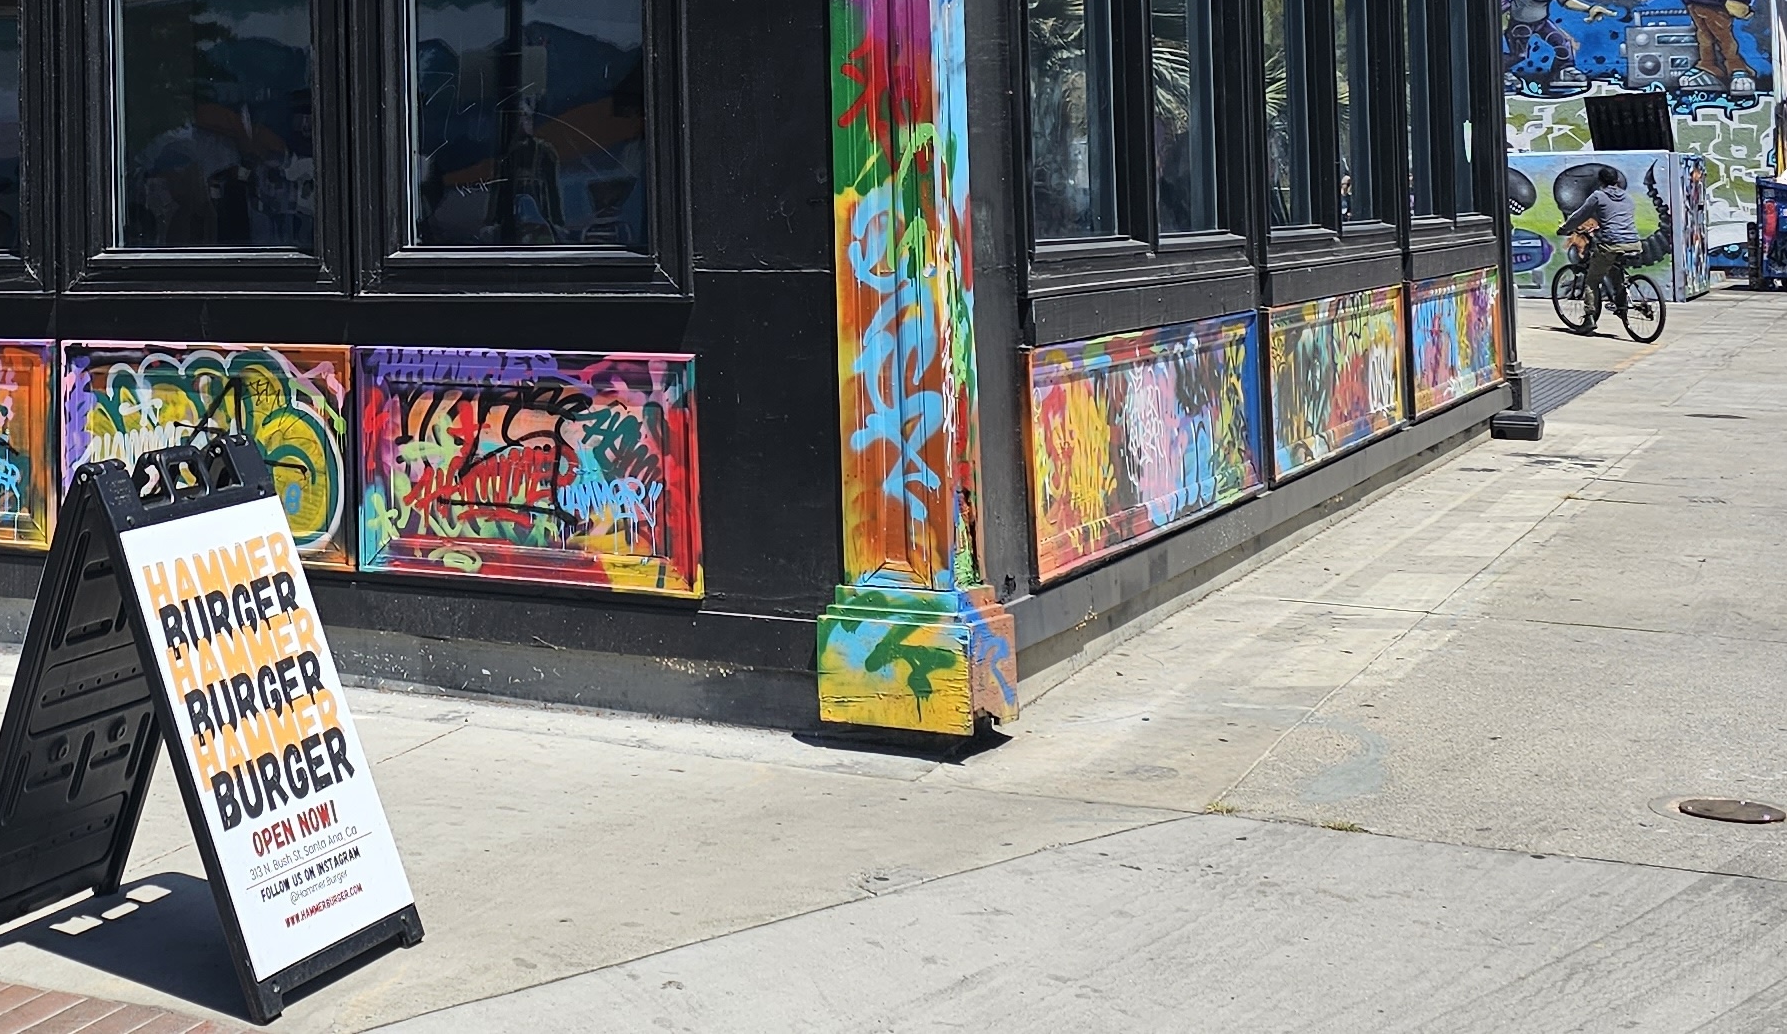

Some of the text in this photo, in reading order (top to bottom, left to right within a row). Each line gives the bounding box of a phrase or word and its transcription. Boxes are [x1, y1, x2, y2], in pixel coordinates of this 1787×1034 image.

[142, 532, 297, 620] HAMMER
[159, 571, 300, 660] BURGER
[166, 608, 322, 705] HAMMER
[184, 651, 326, 747] BURGER
[191, 688, 345, 793] HAMMER
[210, 727, 355, 832] BURGER
[249, 865, 264, 881] 313
[272, 853, 294, 871] Bush
[303, 838, 327, 859] Santa
[345, 825, 358, 837] Ca
[252, 799, 339, 858] OPEN NOW!
[260, 846, 362, 903] FOLLOW US ON INSTAGRAM
